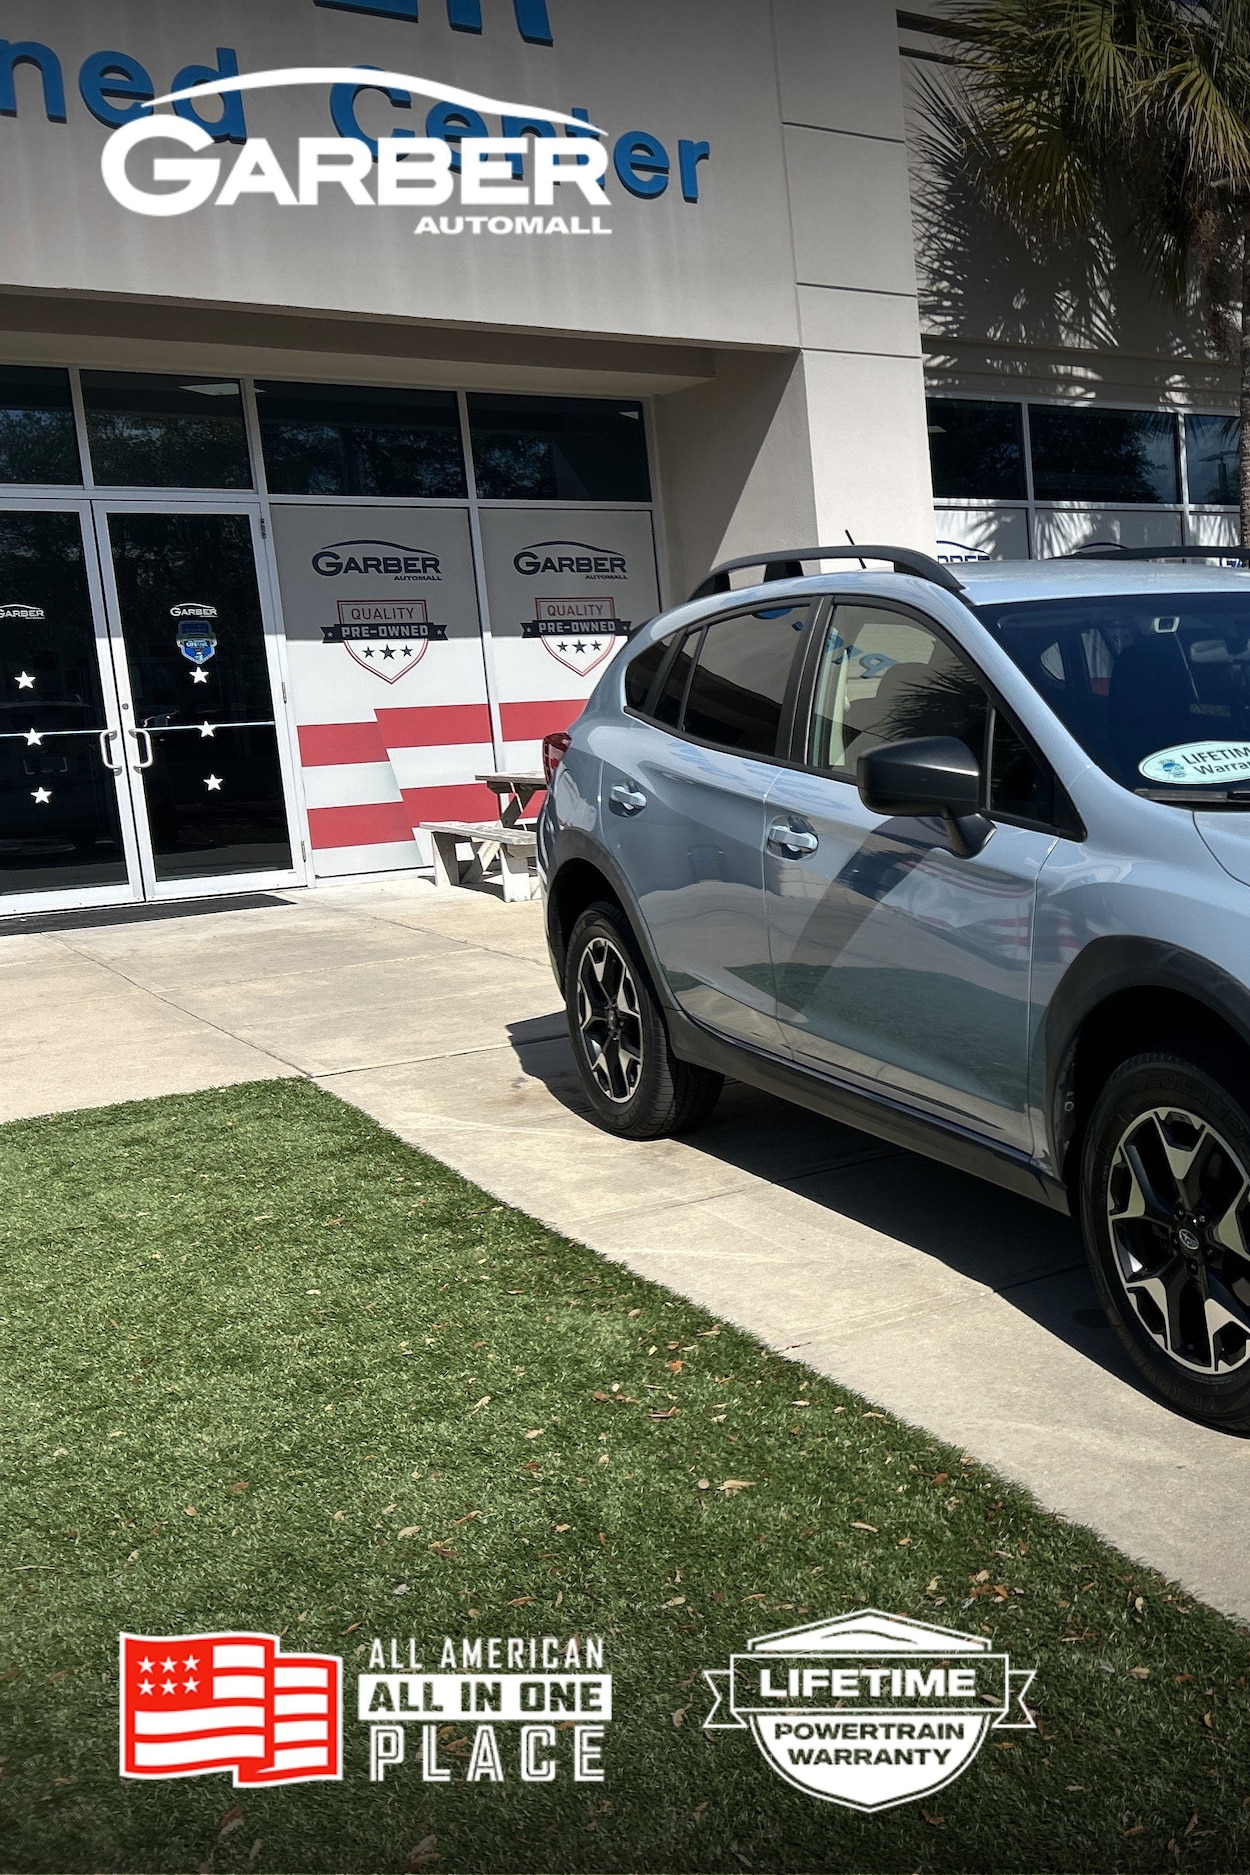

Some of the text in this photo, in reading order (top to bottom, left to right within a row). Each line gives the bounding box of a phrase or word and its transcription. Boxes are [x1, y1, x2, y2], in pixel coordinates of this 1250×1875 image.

[312, 551, 442, 577] GARBER
[513, 551, 628, 576] GARBER
[170, 607, 218, 617] GARBER
[351, 607, 415, 620] QUALITY
[547, 604, 604, 617] QUALITY
[341, 624, 429, 638] PRE-OWNED
[538, 621, 616, 633] PRE-OWNED
